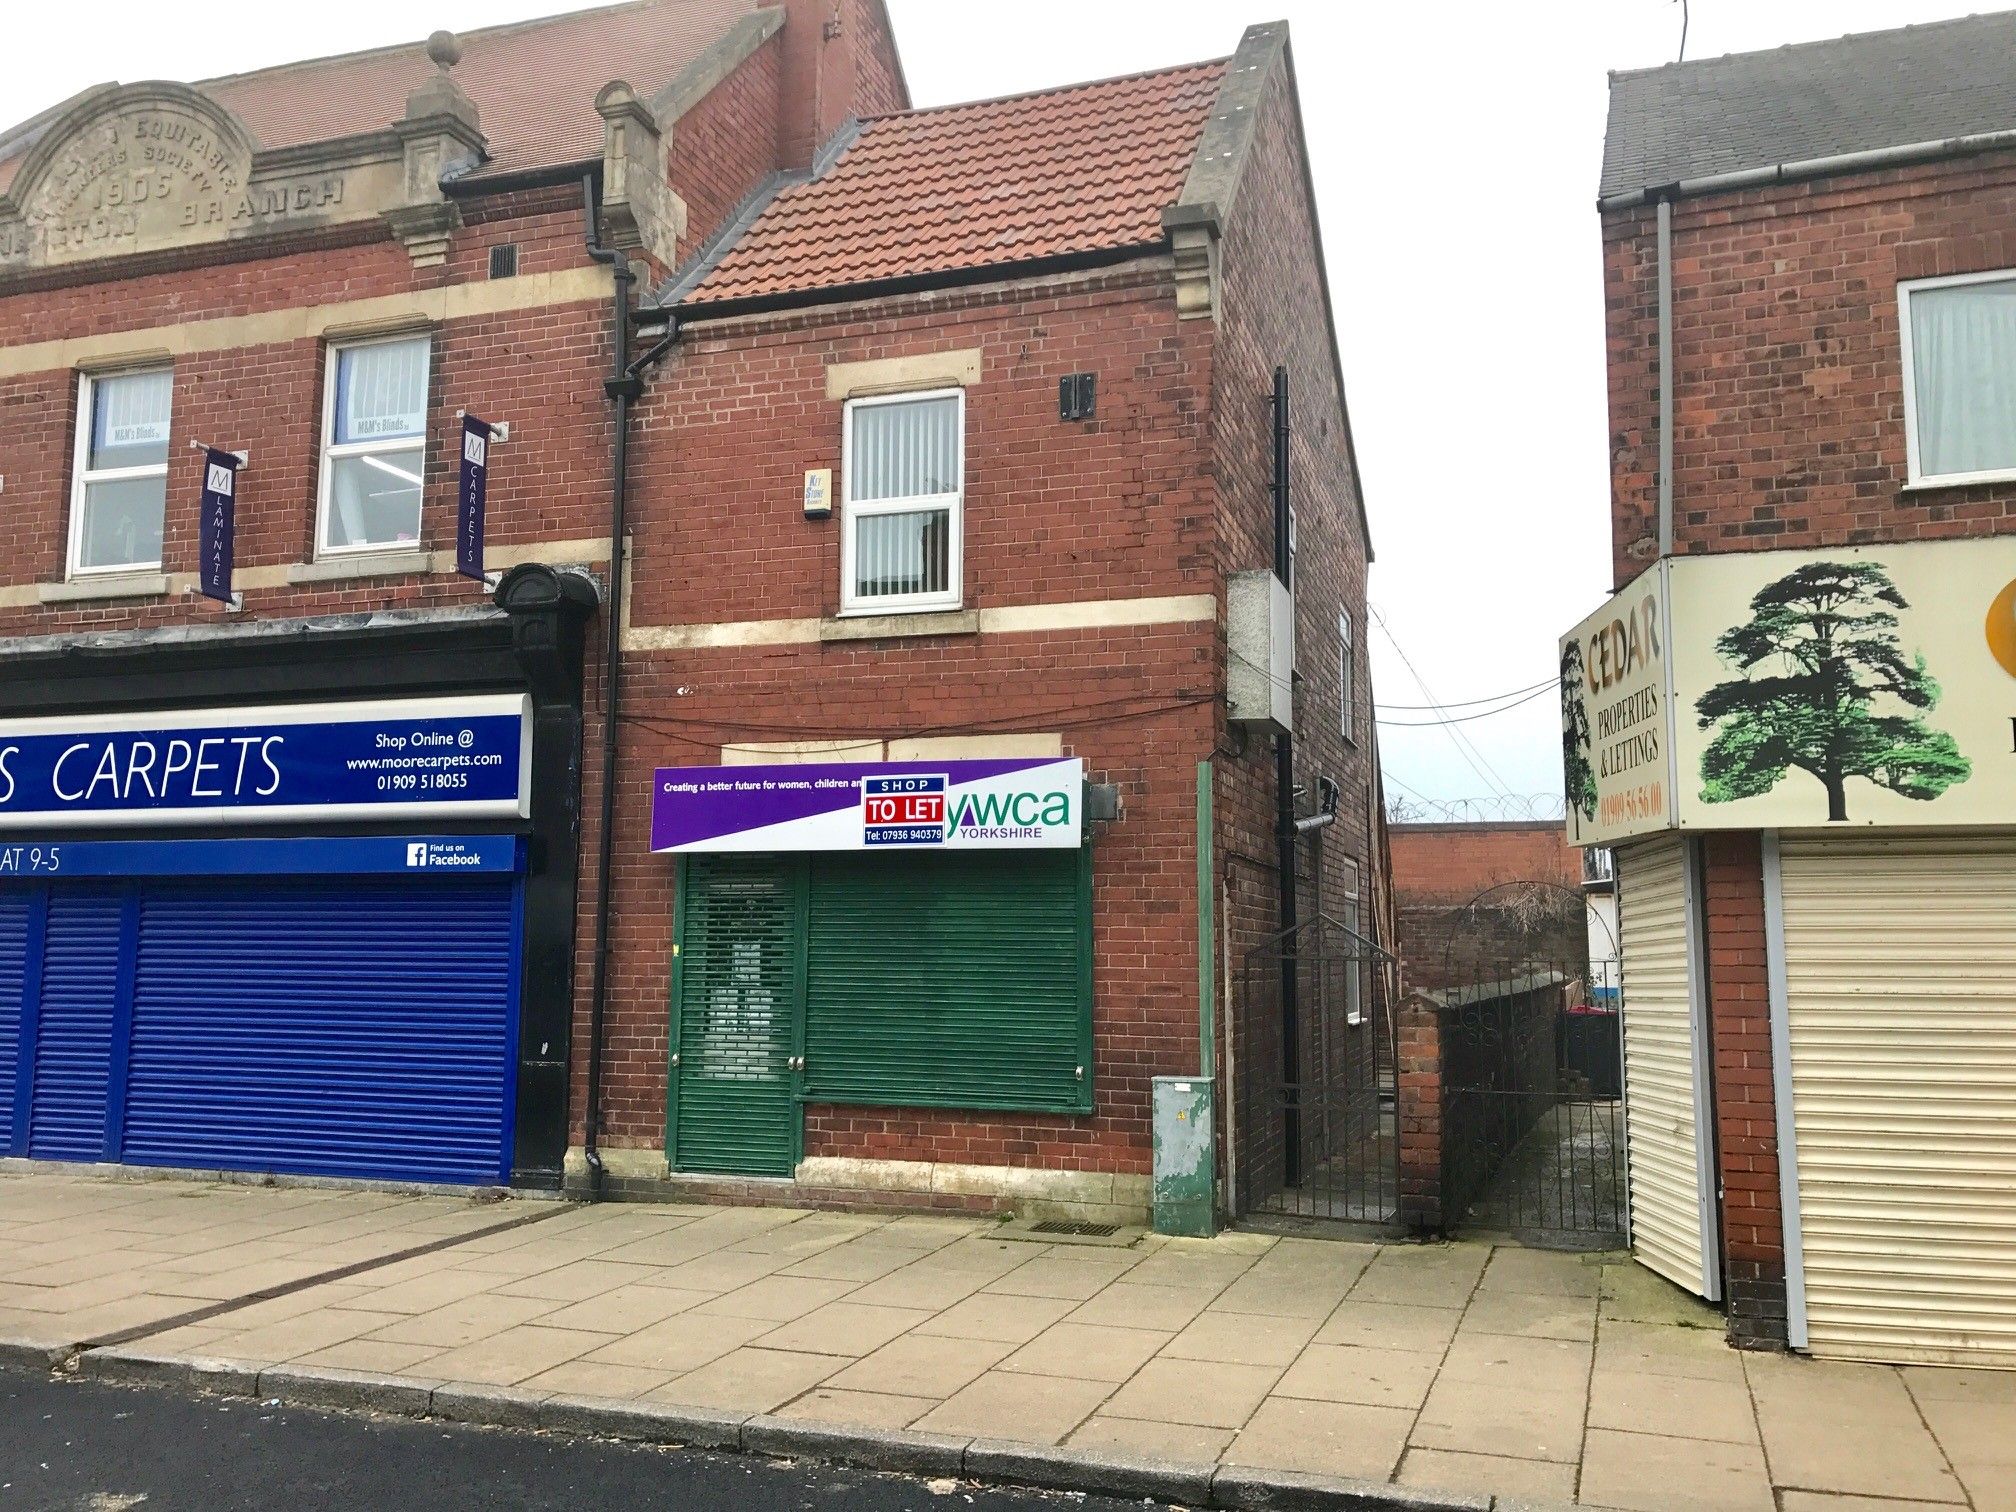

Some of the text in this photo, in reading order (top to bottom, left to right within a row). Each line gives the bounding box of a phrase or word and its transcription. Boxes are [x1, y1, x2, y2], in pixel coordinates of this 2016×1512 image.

[134, 119, 238, 195] EQUITABLE
[143, 146, 212, 192] SOCIETY
[94, 171, 173, 213] 1905
[179, 178, 344, 227] BRANCH
[114, 427, 135, 441] M&M's
[136, 426, 155, 440] Blinds
[357, 420, 380, 434] M&M's
[381, 418, 404, 432] Blinds
[467, 438, 482, 460] M
[210, 469, 229, 490] M
[467, 466, 478, 562] CARPETS
[212, 495, 224, 586] LAMINATE
[1588, 593, 1660, 696] CEDAR
[1598, 683, 1658, 741] PROPERTIES
[375, 729, 474, 751] Shop Online @
[346, 753, 502, 771] www.moorecarpets.com
[1600, 727, 1660, 779] & LETTINGS
[52, 735, 285, 801] CARPETS
[377, 773, 468, 790] 01909 518055
[663, 782, 698, 793] Creating
[706, 782, 733, 791] better
[735, 780, 761, 791] future
[762, 780, 776, 790] for
[777, 781, 813, 790] women,
[814, 778, 849, 789] children
[850, 780, 862, 788] an
[881, 780, 929, 791] SHOP
[868, 798, 941, 821] TO LET
[1600, 793, 1625, 828] 01909
[1650, 781, 1662, 816] 00
[865, 829, 942, 841] Tel: 07936 940379
[960, 827, 1042, 839] YORKSHIRE
[429, 843, 465, 852] Find us on
[30, 847, 60, 871] 9-5
[429, 852, 481, 866] Facebook
